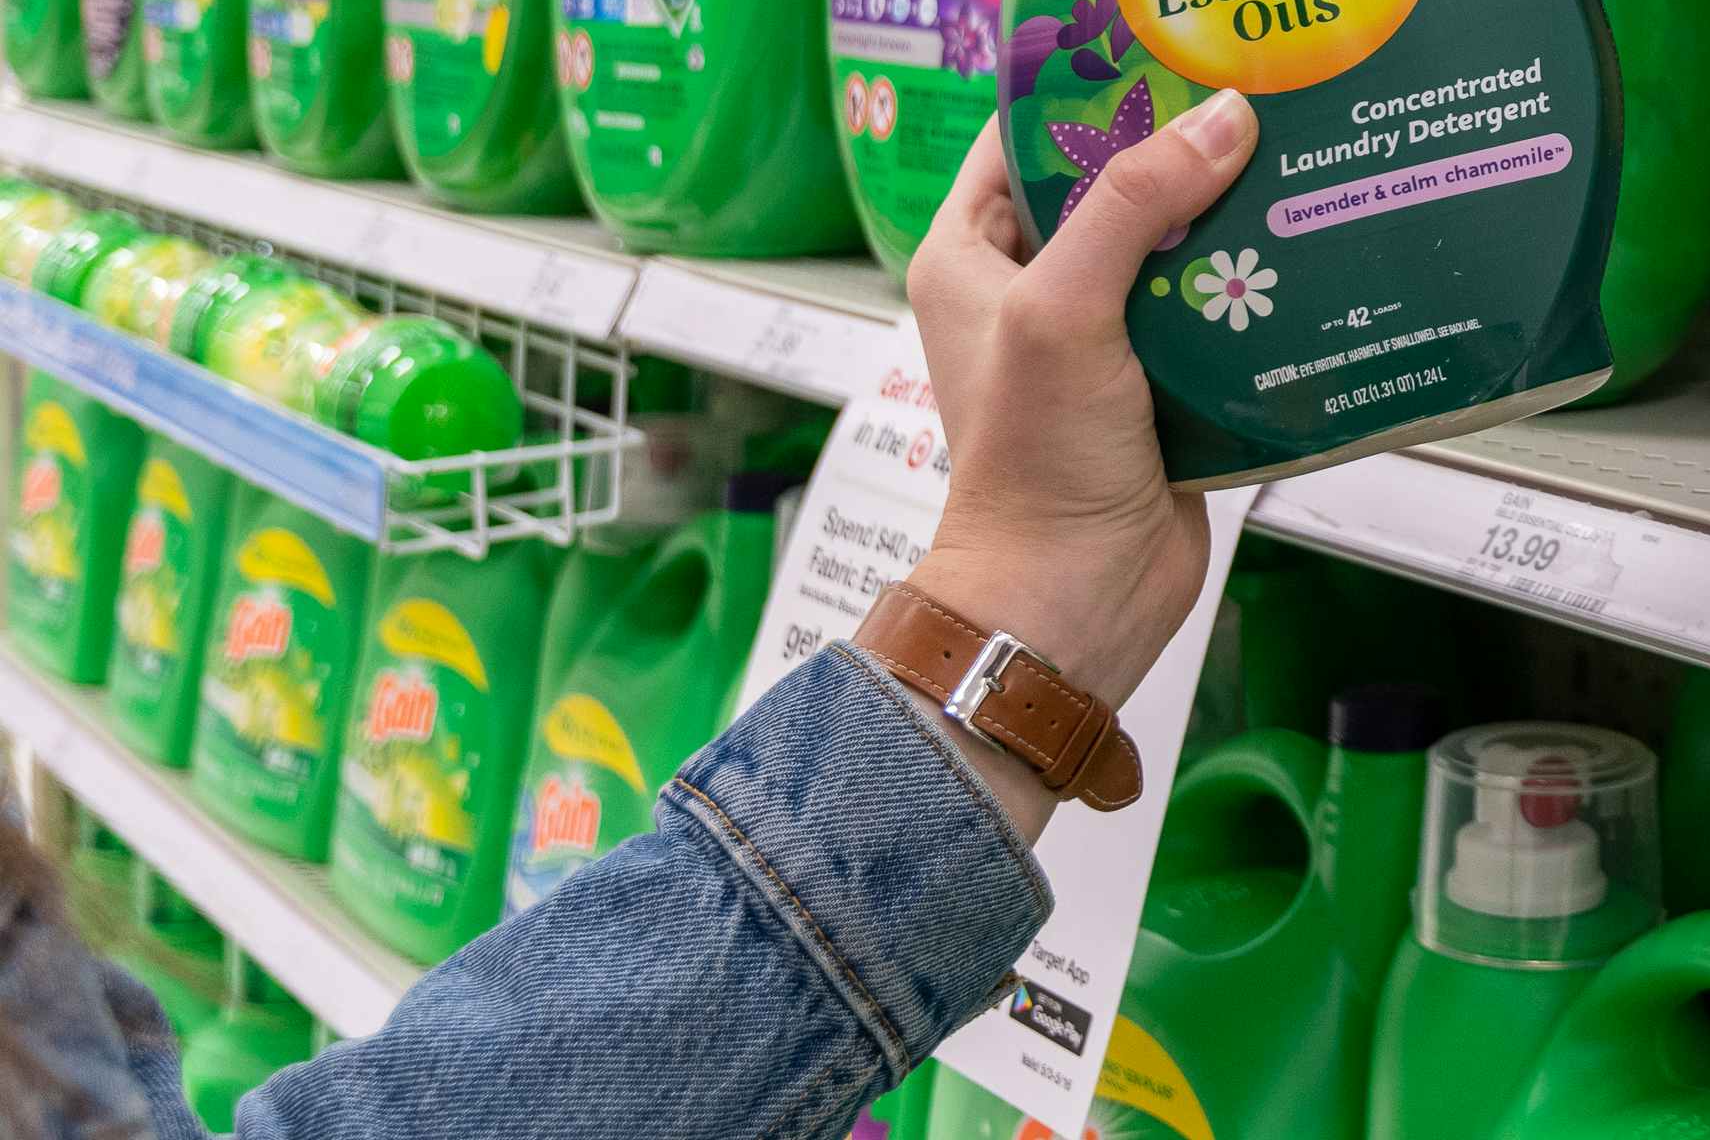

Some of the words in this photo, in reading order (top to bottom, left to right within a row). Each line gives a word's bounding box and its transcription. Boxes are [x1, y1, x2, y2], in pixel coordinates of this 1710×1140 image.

[1351, 57, 1542, 125] Concentrated
[1281, 129, 1400, 177] Laundry
[1409, 92, 1550, 144] Detergent
[1285, 189, 1370, 224] lavender
[1374, 185, 1387, 201] &
[1391, 173, 1438, 197] calm
[1347, 307, 1372, 329] 42
[1254, 363, 1300, 391] CAUTION:
[1300, 363, 1315, 378] EYE
[1348, 342, 1382, 363] HARMFUL
[1391, 327, 1438, 352] SWALLOWED.
[1324, 397, 1340, 415] 42
[1340, 393, 1354, 411] FL
[1354, 387, 1370, 406] OZ
[1369, 379, 1396, 402] (1.31
[1398, 371, 1415, 392] QT)
[1415, 368, 1438, 387] 1.24
[1439, 365, 1447, 381] L
[854, 418, 873, 444] in
[876, 421, 906, 459] the
[1502, 491, 1531, 510] GAIN
[823, 506, 876, 549] Spend
[877, 527, 906, 560] $40
[1479, 523, 1560, 571] 13.99
[809, 546, 859, 585] Fabric
[784, 623, 822, 661] get
[1032, 940, 1065, 972] Target
[1066, 960, 1090, 986] App
